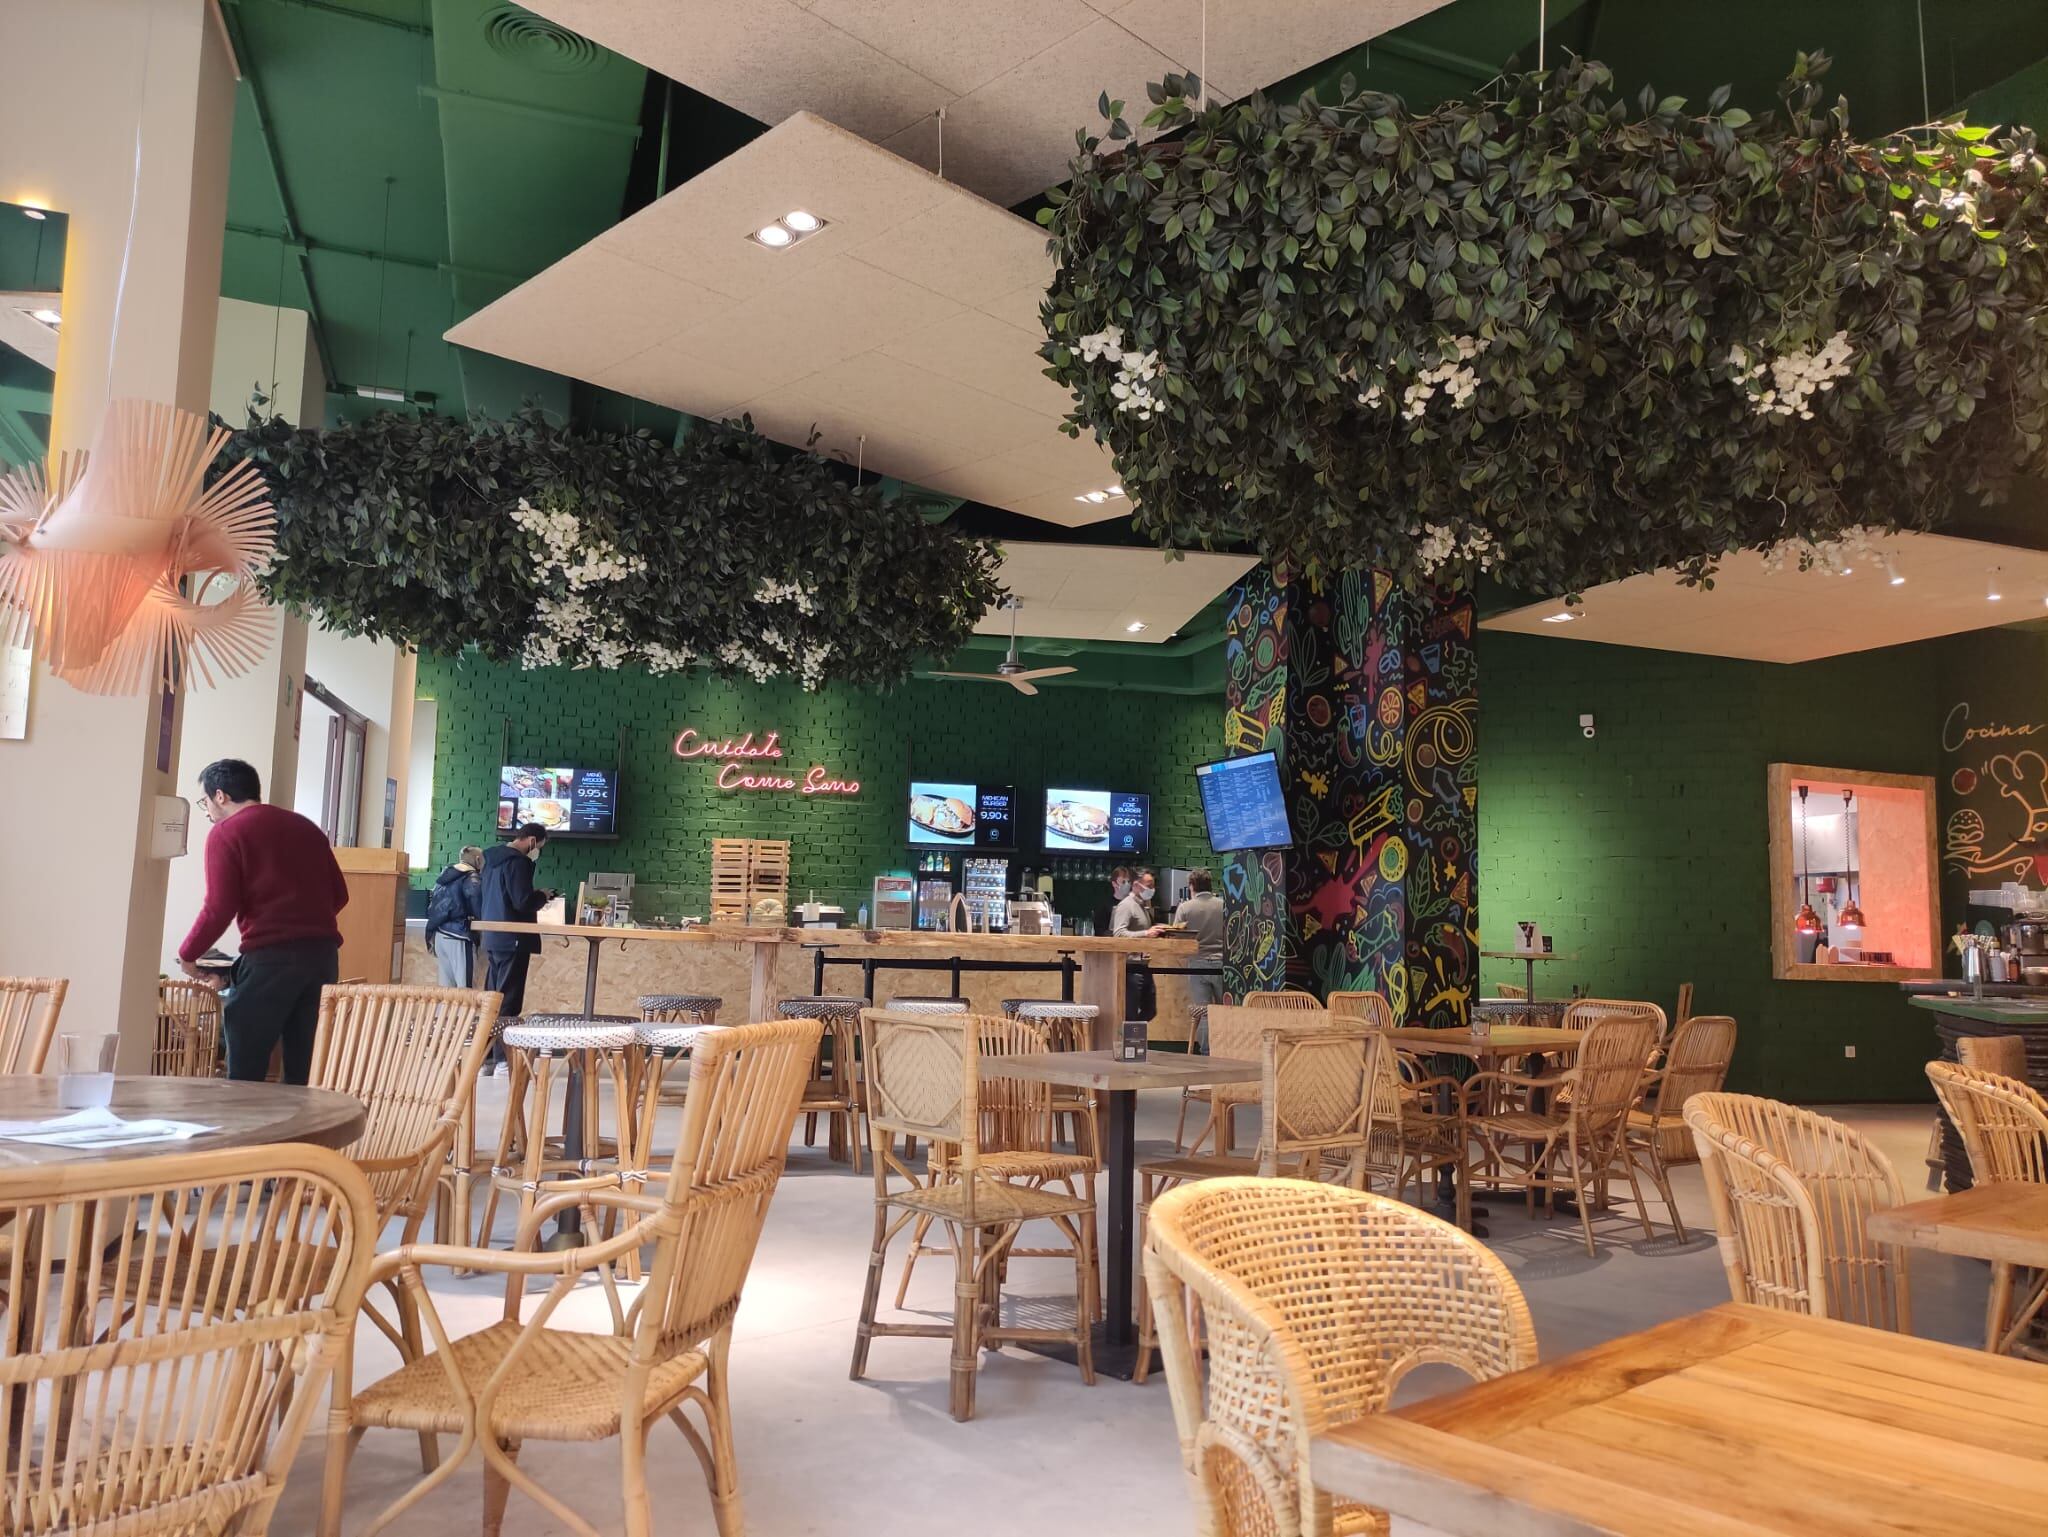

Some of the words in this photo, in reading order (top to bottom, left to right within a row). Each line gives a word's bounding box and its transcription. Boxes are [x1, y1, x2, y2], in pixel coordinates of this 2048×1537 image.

[1942, 702, 2046, 752] Cocina
[719, 763, 796, 789] Come
[802, 767, 860, 794] Sano
[577, 788, 601, 798] 9,95
[980, 811, 1002, 820] 9,90
